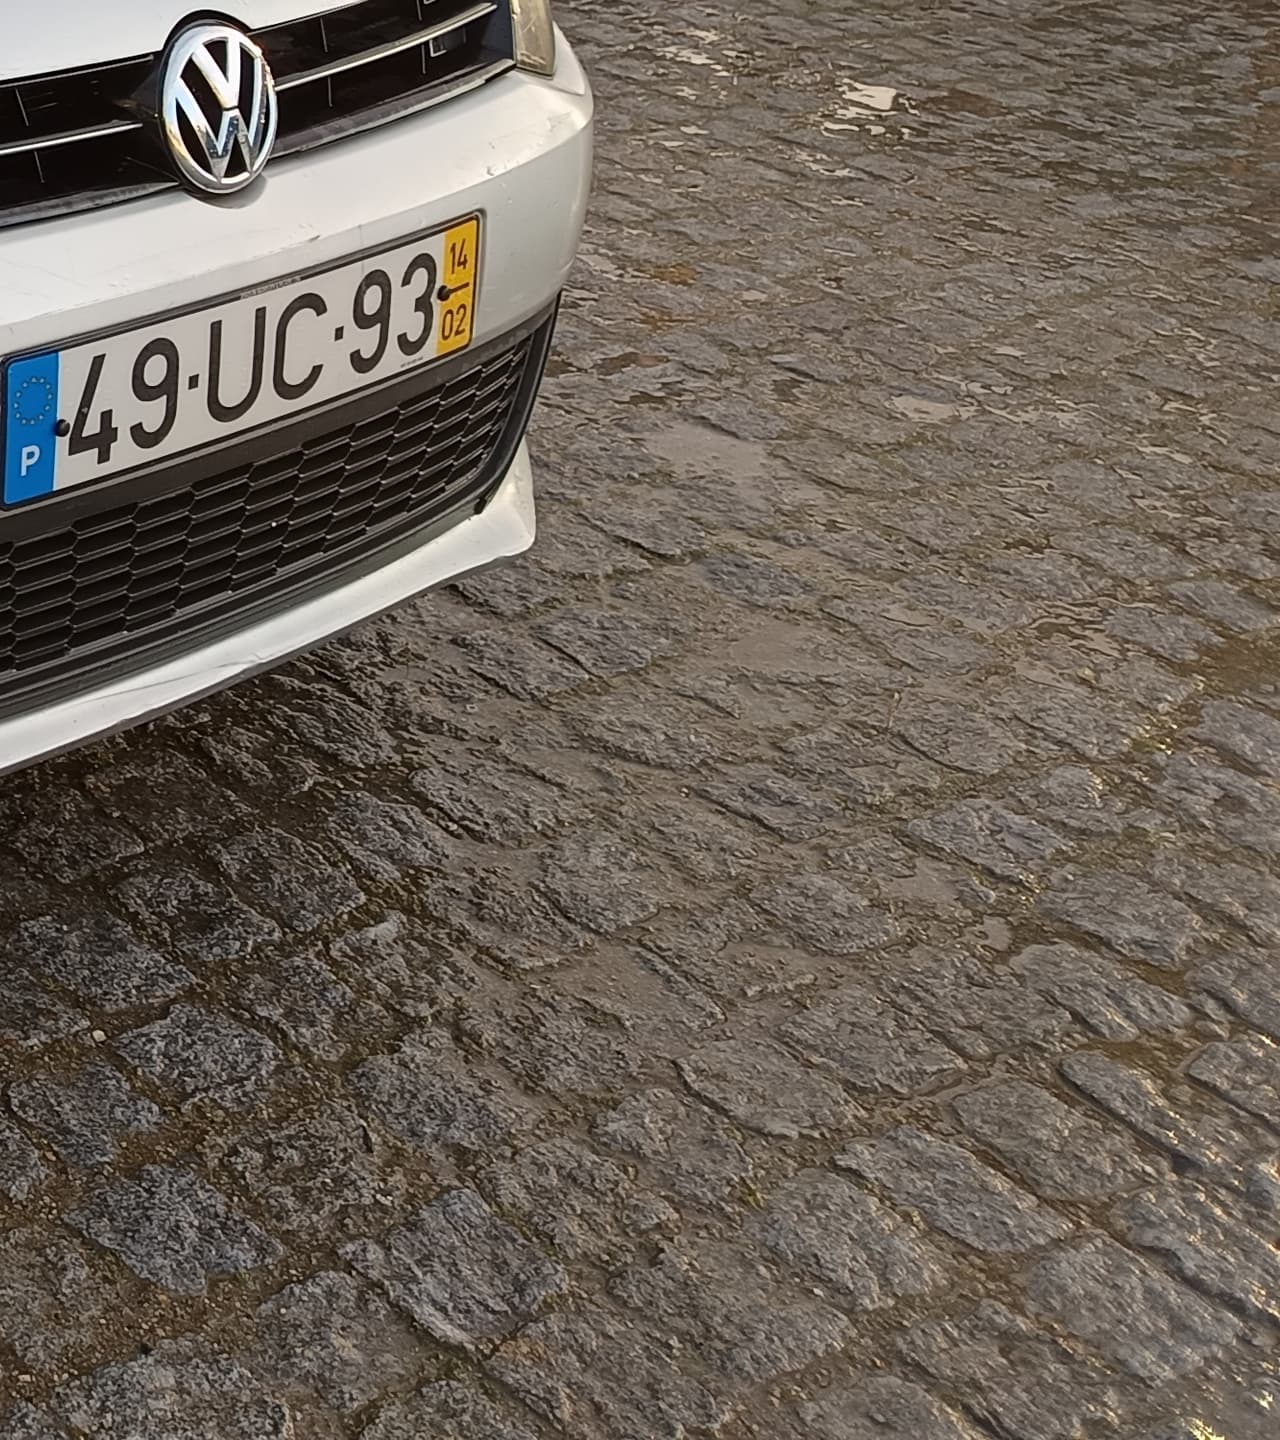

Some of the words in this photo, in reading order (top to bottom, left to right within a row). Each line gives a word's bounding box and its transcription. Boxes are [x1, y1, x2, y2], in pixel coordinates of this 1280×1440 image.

[449, 237, 468, 275] 14
[441, 302, 467, 342] 02
[19, 445, 41, 476] P
